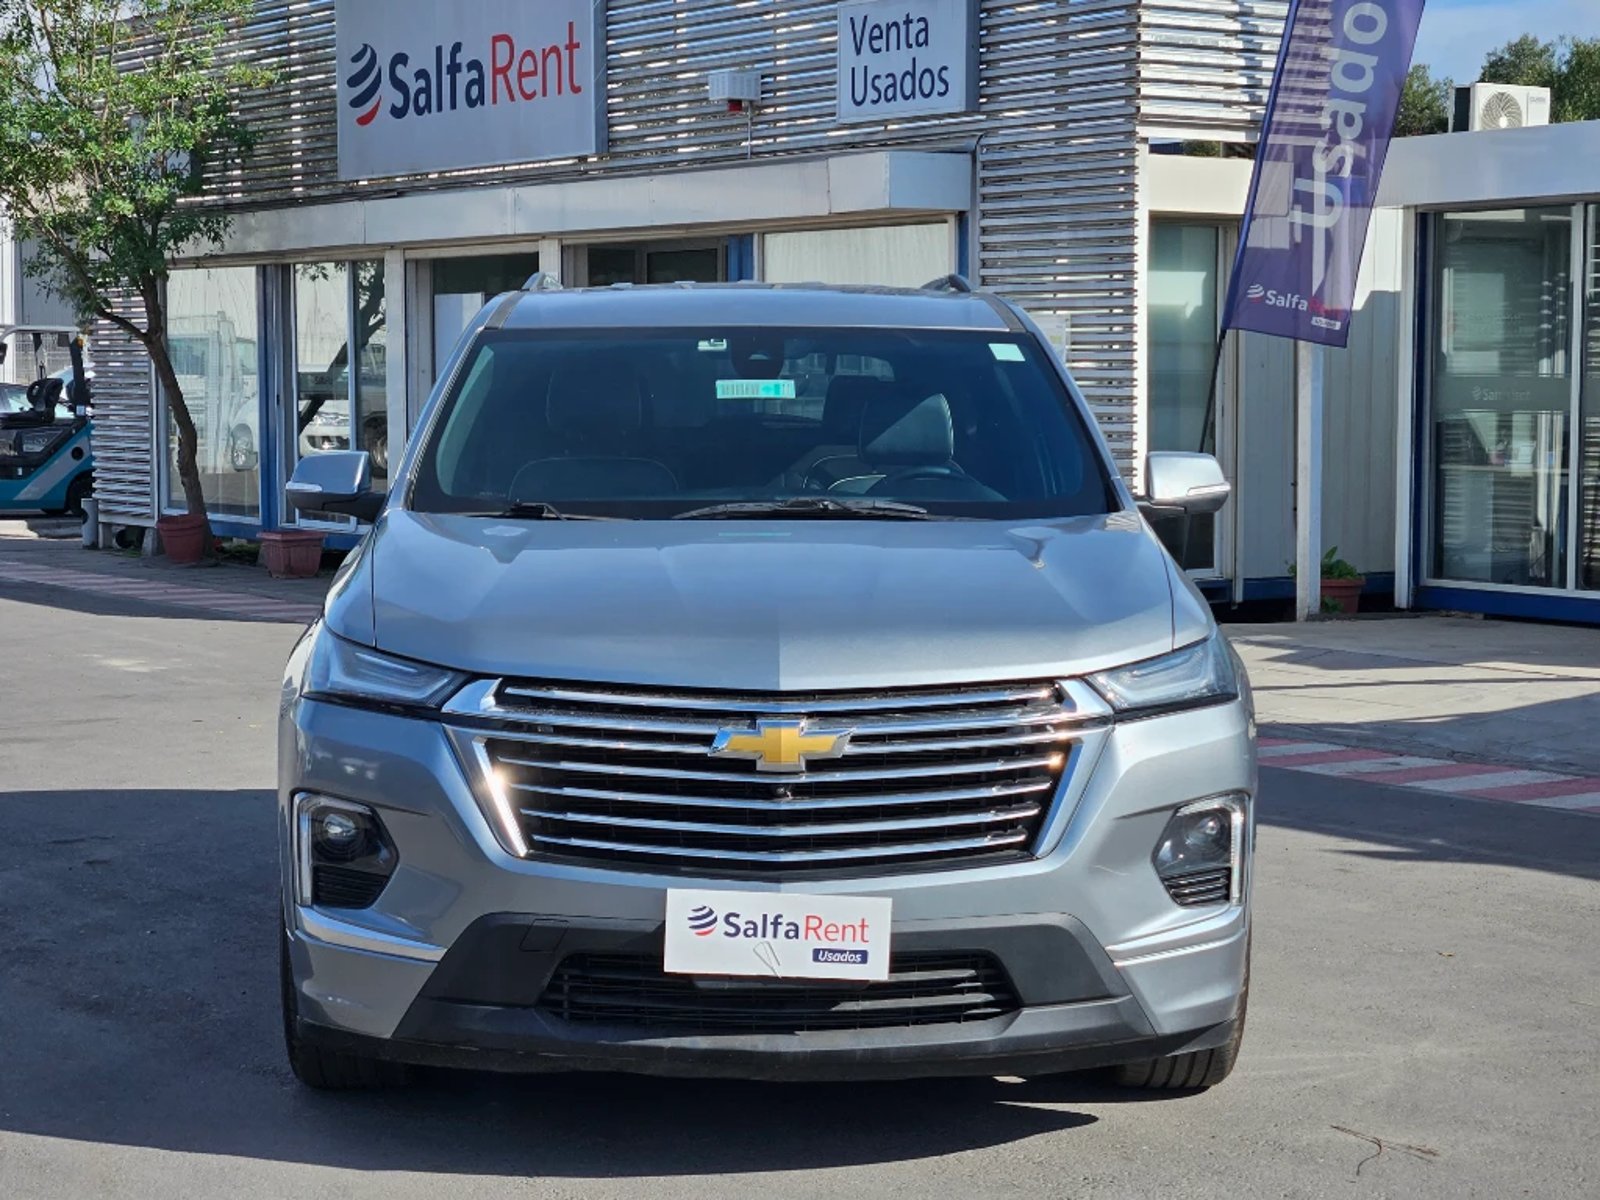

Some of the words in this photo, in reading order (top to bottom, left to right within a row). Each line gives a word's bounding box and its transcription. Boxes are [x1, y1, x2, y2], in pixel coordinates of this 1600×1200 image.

[850, 12, 929, 56] Venta
[389, 21, 582, 119] SalfaRent
[851, 57, 949, 107] Usados
[723, 911, 869, 943] SalfaRent
[817, 950, 863, 963] Usados
